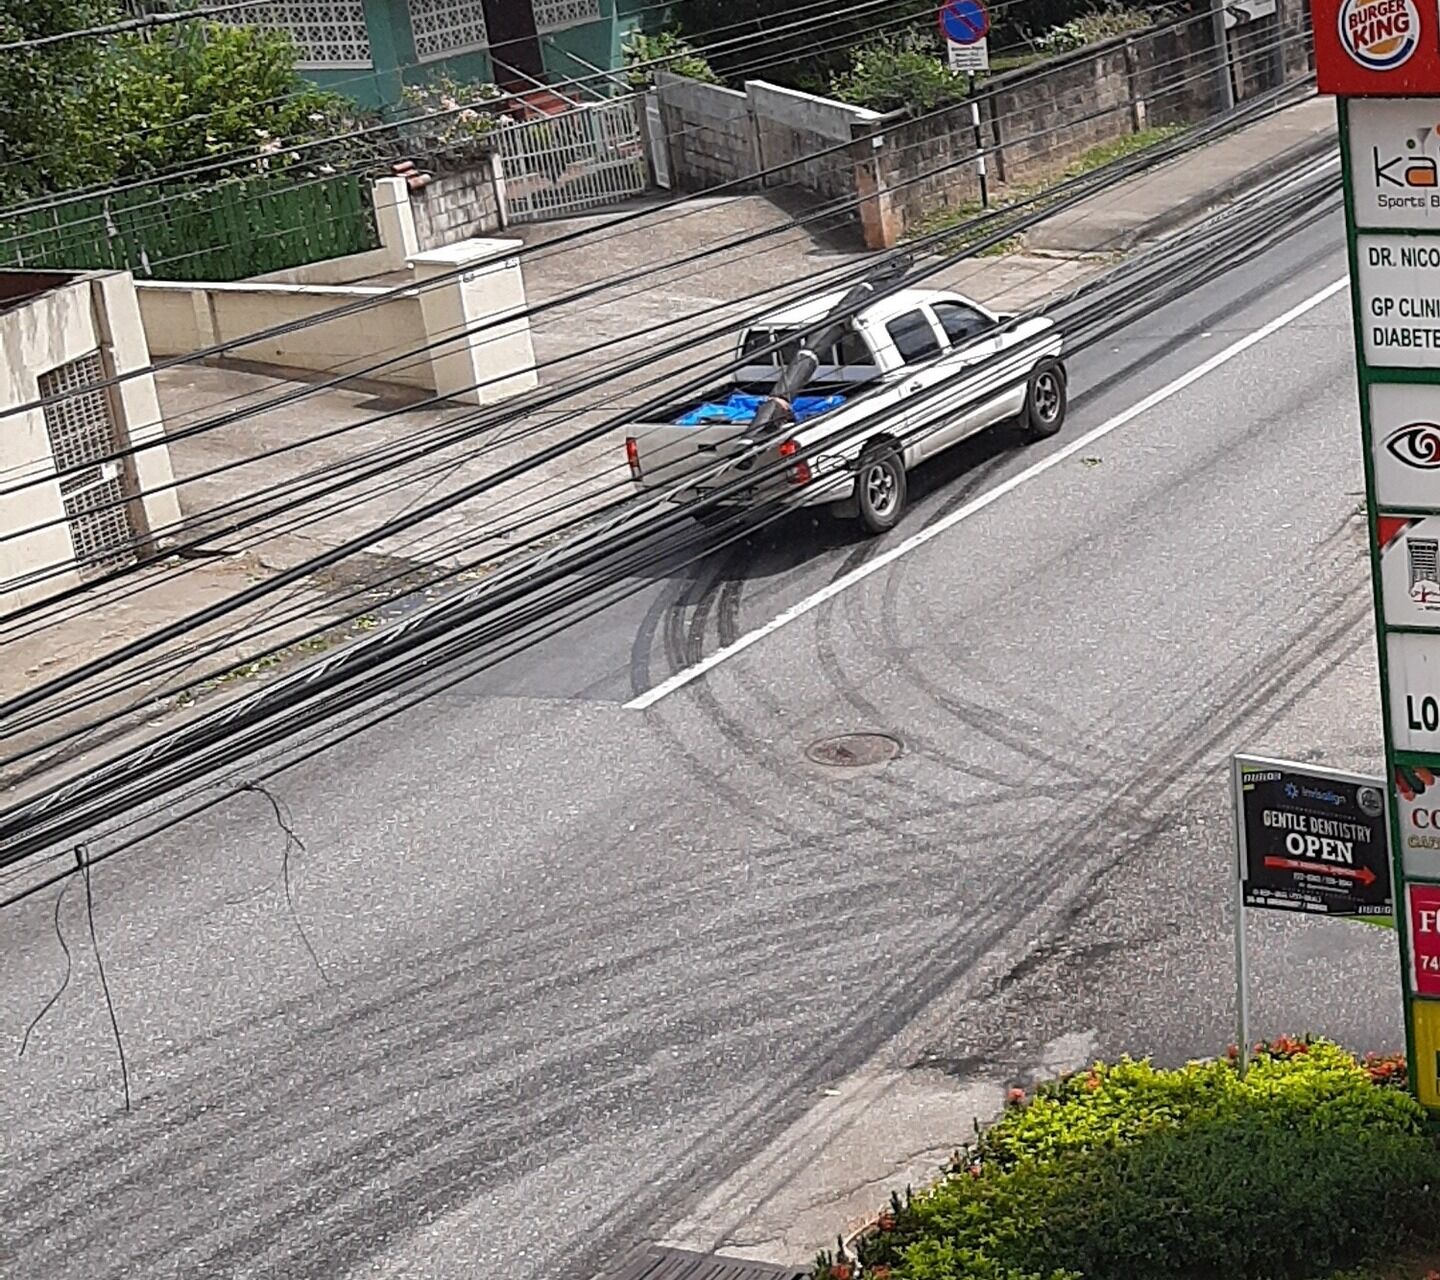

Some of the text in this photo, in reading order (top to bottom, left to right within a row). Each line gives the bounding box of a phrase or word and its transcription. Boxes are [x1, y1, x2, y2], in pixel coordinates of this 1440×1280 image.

[1353, 13, 1409, 51] KING
[1378, 194, 1425, 209] Sports
[1369, 248, 1397, 268] DR.
[1371, 298, 1394, 317] GP
[1263, 810, 1307, 831] GENTLE
[1310, 817, 1372, 843] DENTISTRY
[1286, 833, 1353, 863] OPEN
